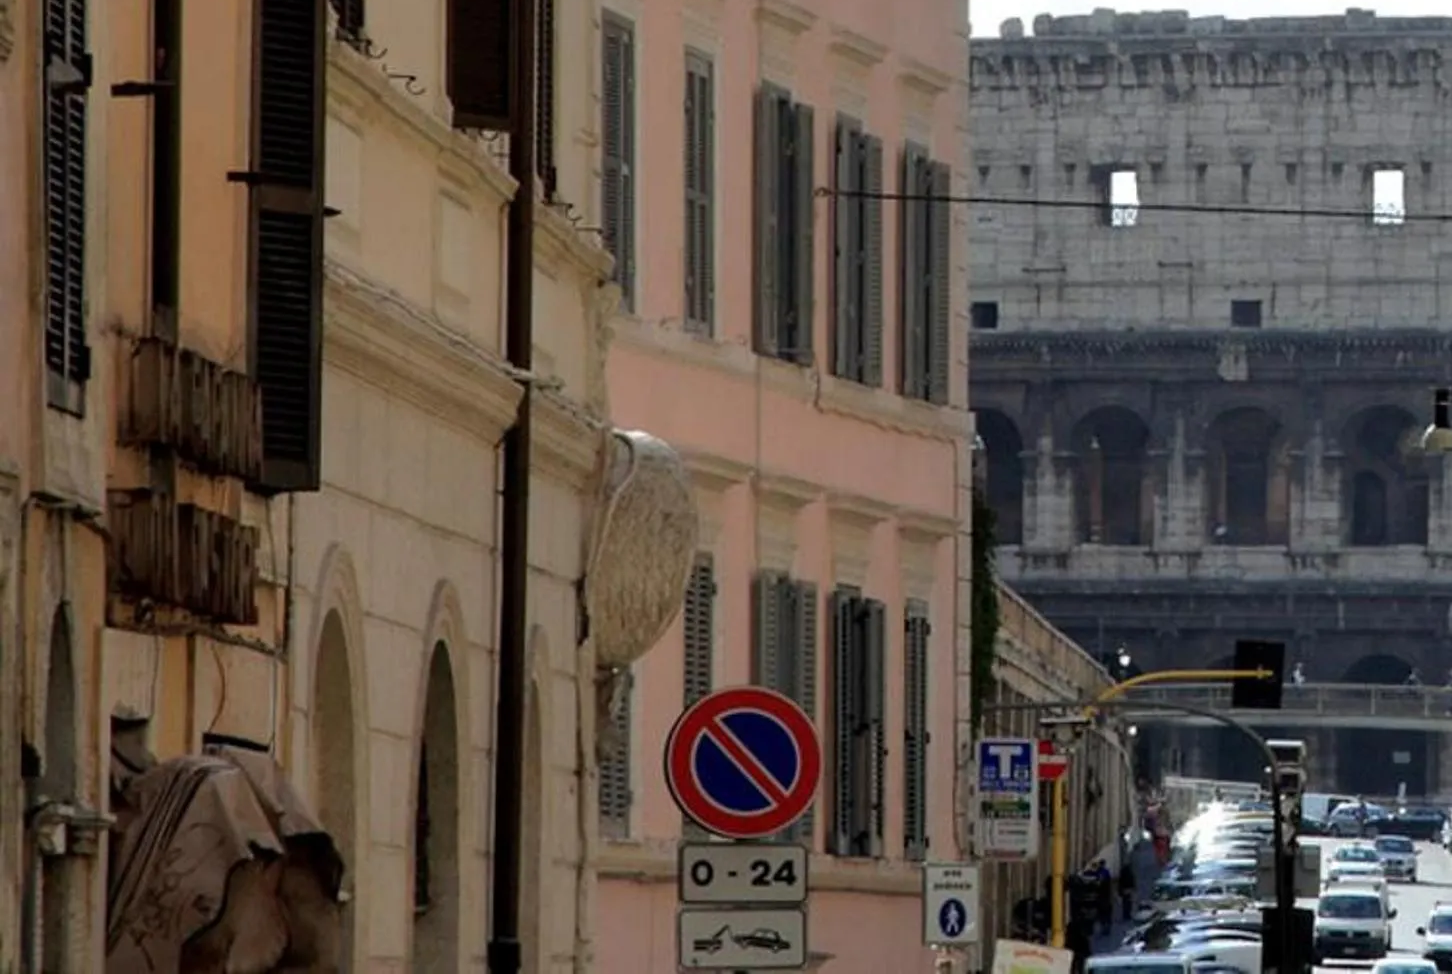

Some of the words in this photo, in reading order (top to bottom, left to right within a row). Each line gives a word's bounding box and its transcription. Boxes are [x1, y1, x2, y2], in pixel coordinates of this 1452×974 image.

[988, 745, 1024, 778] T
[691, 859, 714, 886] 0
[750, 859, 797, 886] 24
